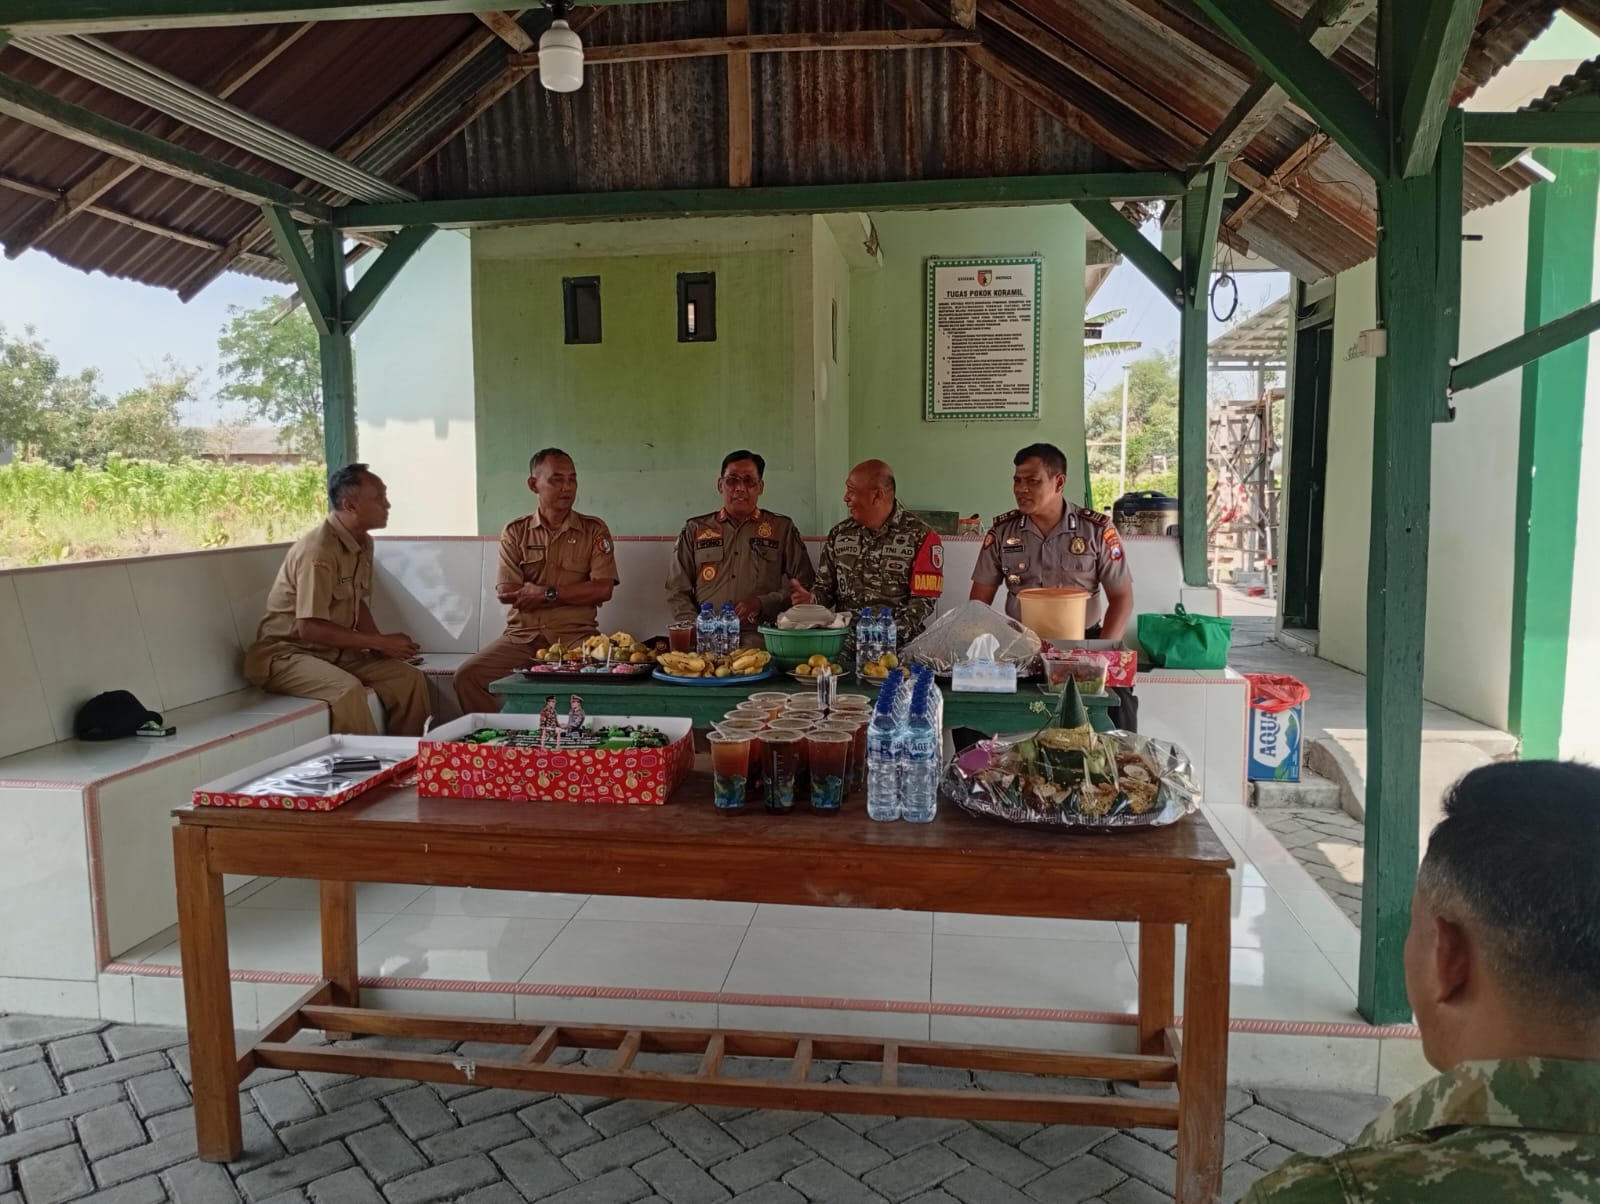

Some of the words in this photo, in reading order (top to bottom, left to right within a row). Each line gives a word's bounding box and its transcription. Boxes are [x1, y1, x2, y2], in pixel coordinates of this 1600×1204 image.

[946, 290, 968, 298] TUGAS
[970, 289, 992, 297] POKOK
[994, 288, 1024, 296] KORAMIL
[885, 546, 897, 554] TNI
[901, 548, 913, 556] AD
[914, 574, 943, 592] DANRA
[1259, 711, 1280, 758] AQUA
